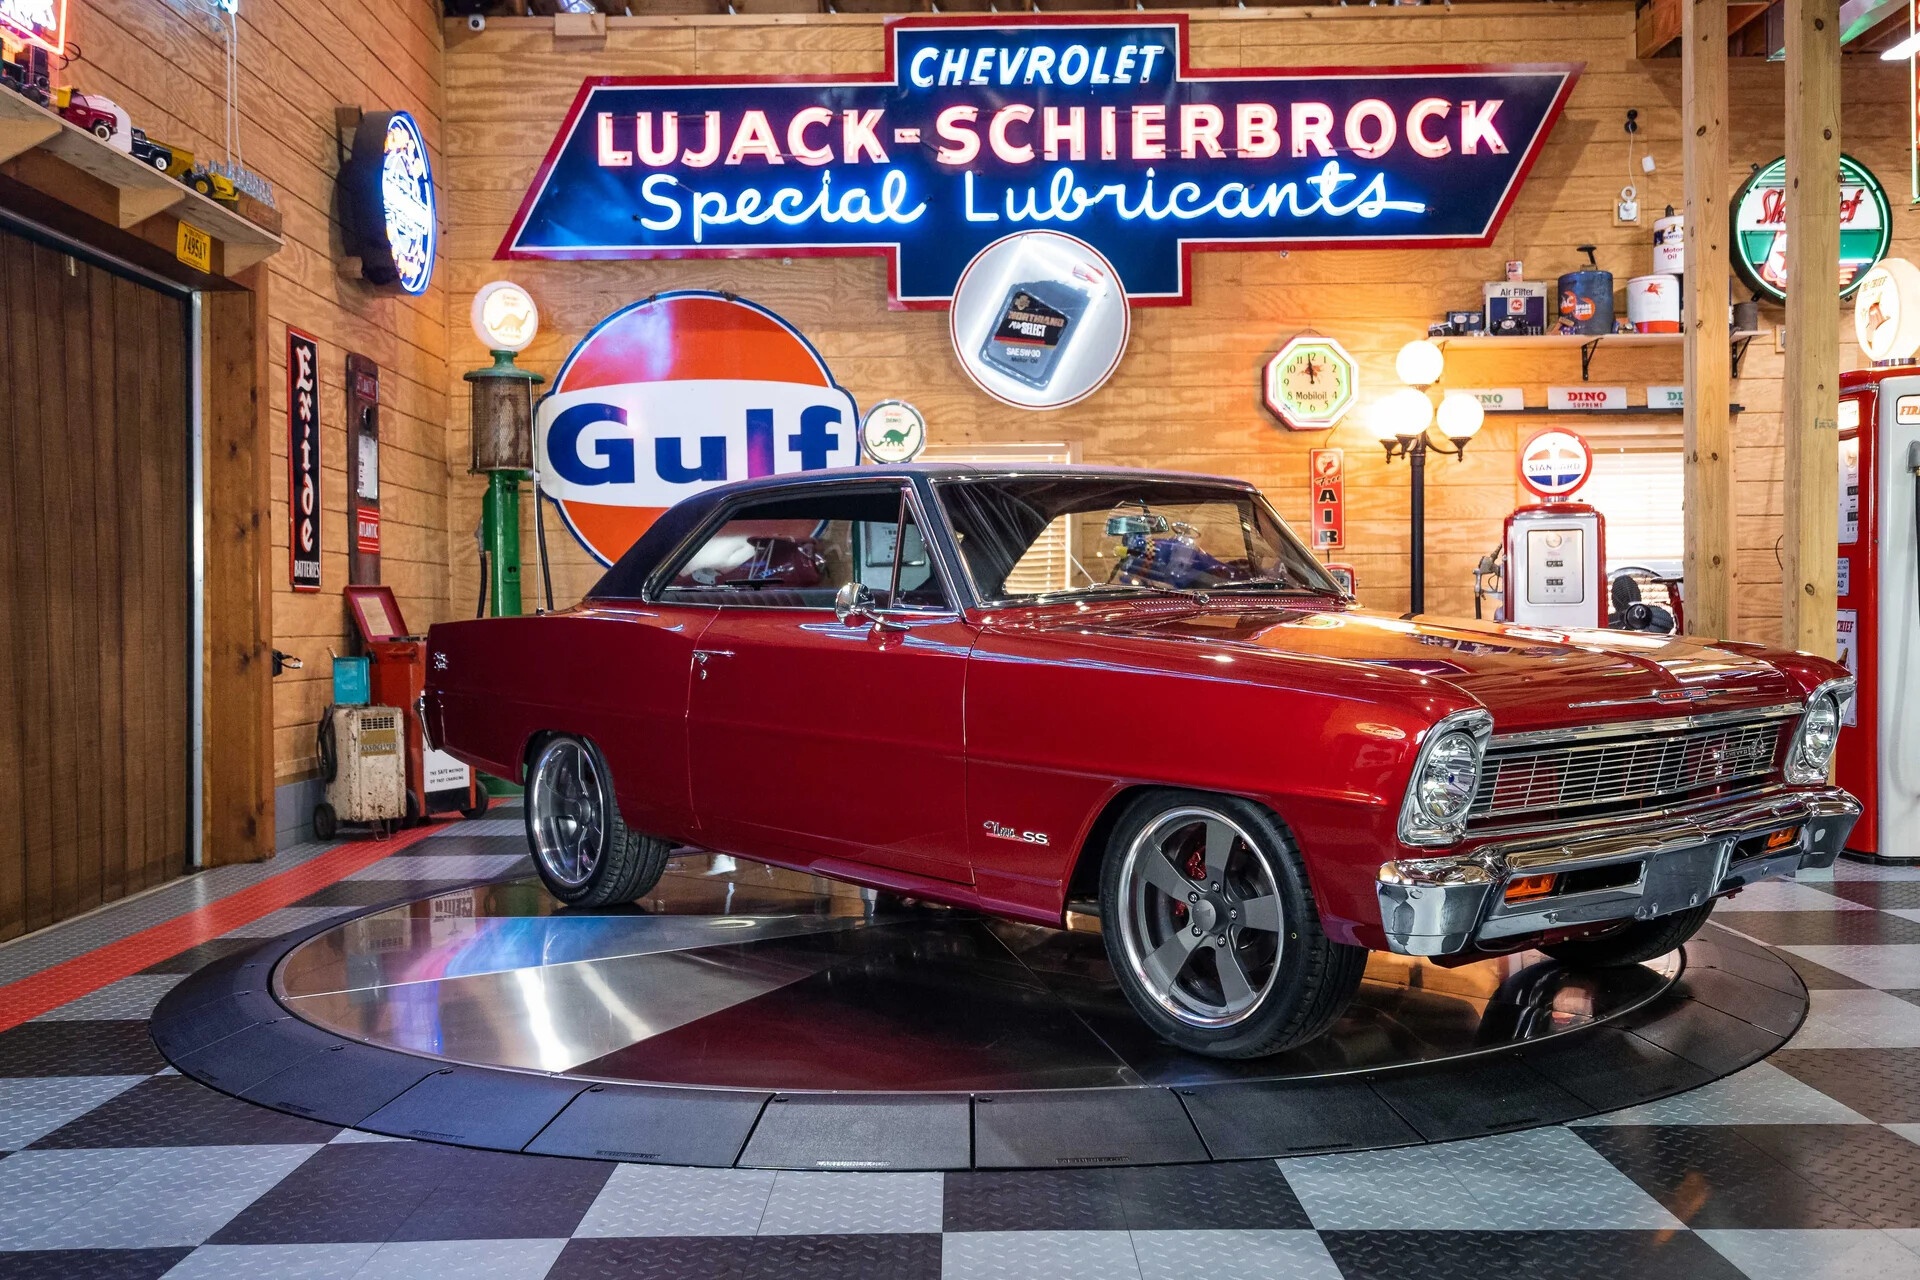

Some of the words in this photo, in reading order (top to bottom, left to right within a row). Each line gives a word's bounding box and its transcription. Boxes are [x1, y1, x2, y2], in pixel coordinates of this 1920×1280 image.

[910, 45, 1165, 87] CHEVROLET
[597, 98, 1509, 167] LUJACK-SCHIERBROCK
[640, 169, 927, 243] Special
[965, 160, 1425, 222] Lubricants
[1500, 288, 1513, 296] Air
[1514, 288, 1534, 296] Filter
[1512, 301, 1522, 309] AC
[1561, 295, 1574, 308] AC
[1021, 322, 1047, 337] SELECT
[1006, 347, 1020, 356] SAE
[1295, 391, 1327, 400] Mobiloil
[1475, 394, 1503, 404] INO
[1567, 391, 1607, 402] DINO
[547, 403, 842, 487] Gulf
[1319, 488, 1338, 543] AIR
[294, 560, 320, 578] BATTERIES
[1022, 831, 1048, 845] SS
